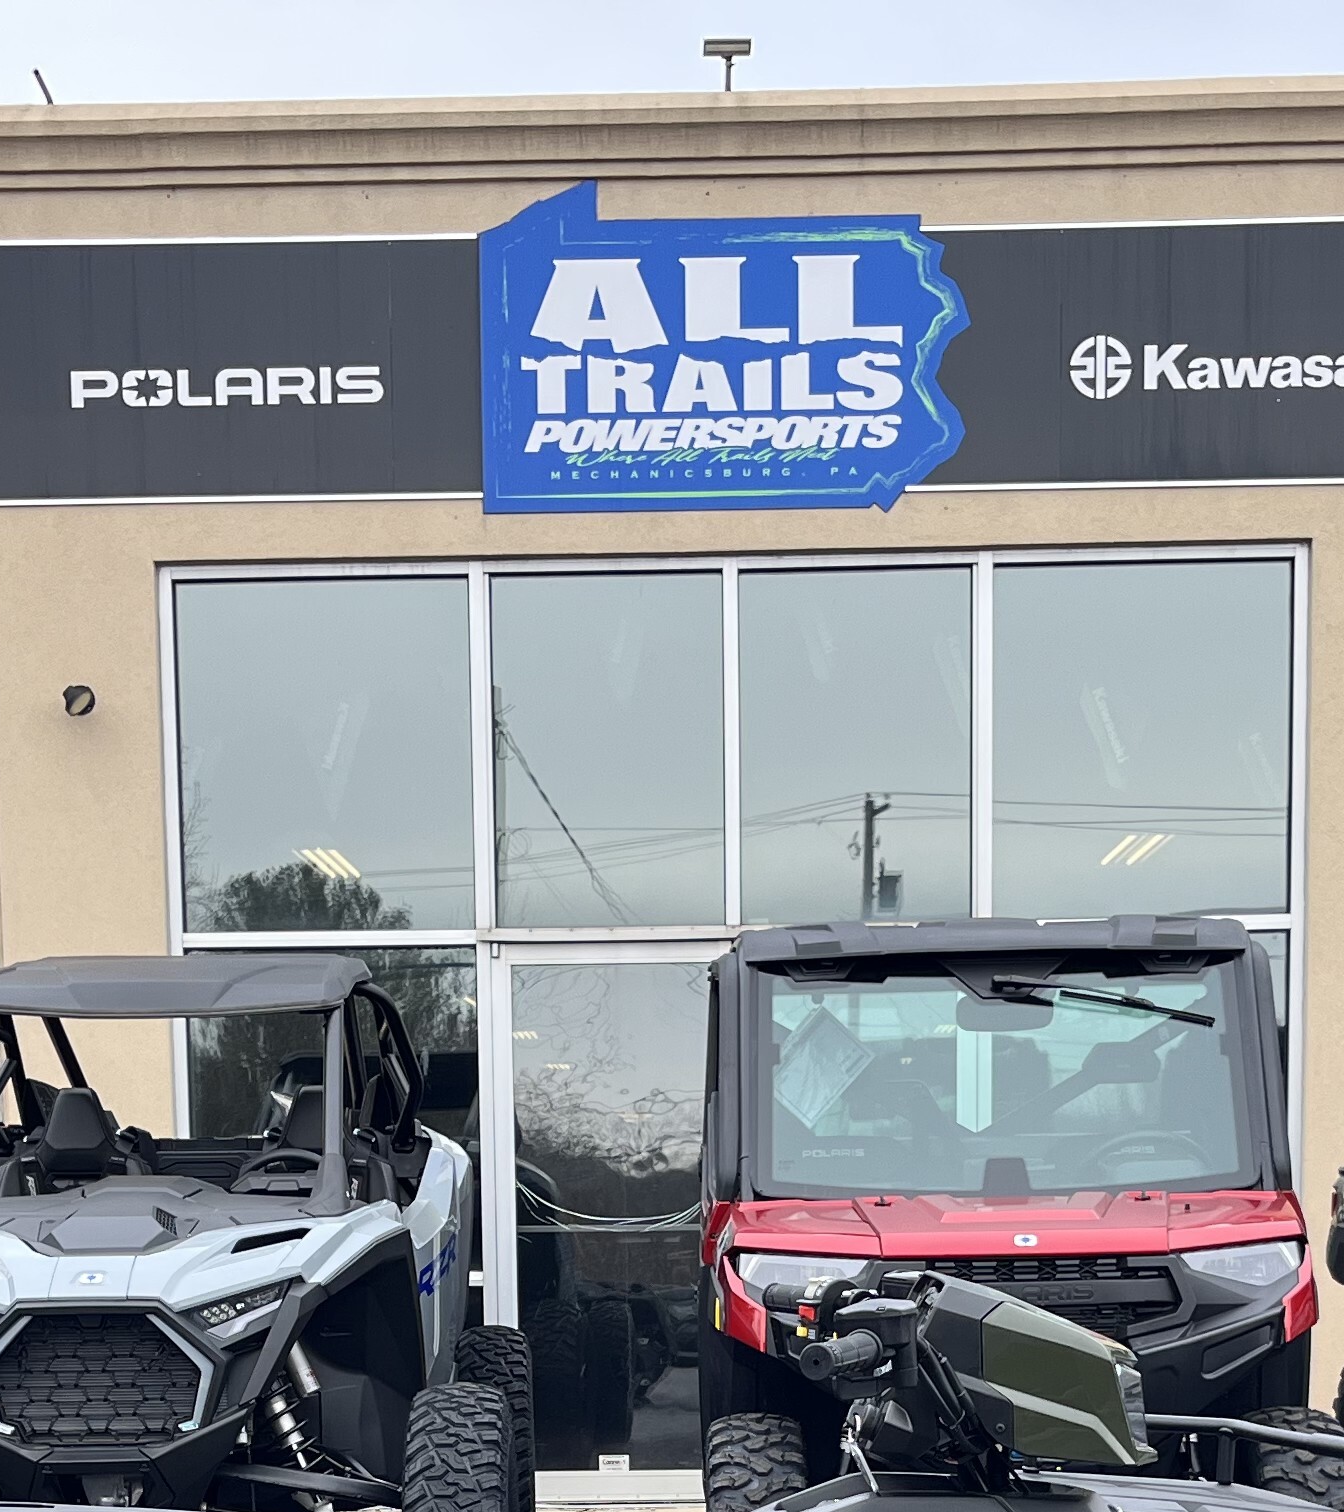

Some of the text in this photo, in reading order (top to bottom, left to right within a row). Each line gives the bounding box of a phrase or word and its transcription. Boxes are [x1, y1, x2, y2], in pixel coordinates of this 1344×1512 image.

[530, 255, 903, 353] ALL
[70, 366, 384, 409] POLARIS
[521, 351, 903, 414] TRAILS
[524, 415, 901, 453] POWERSPORTS
[830, 466, 858, 476] PA
[802, 1148, 865, 1158] POLARIS
